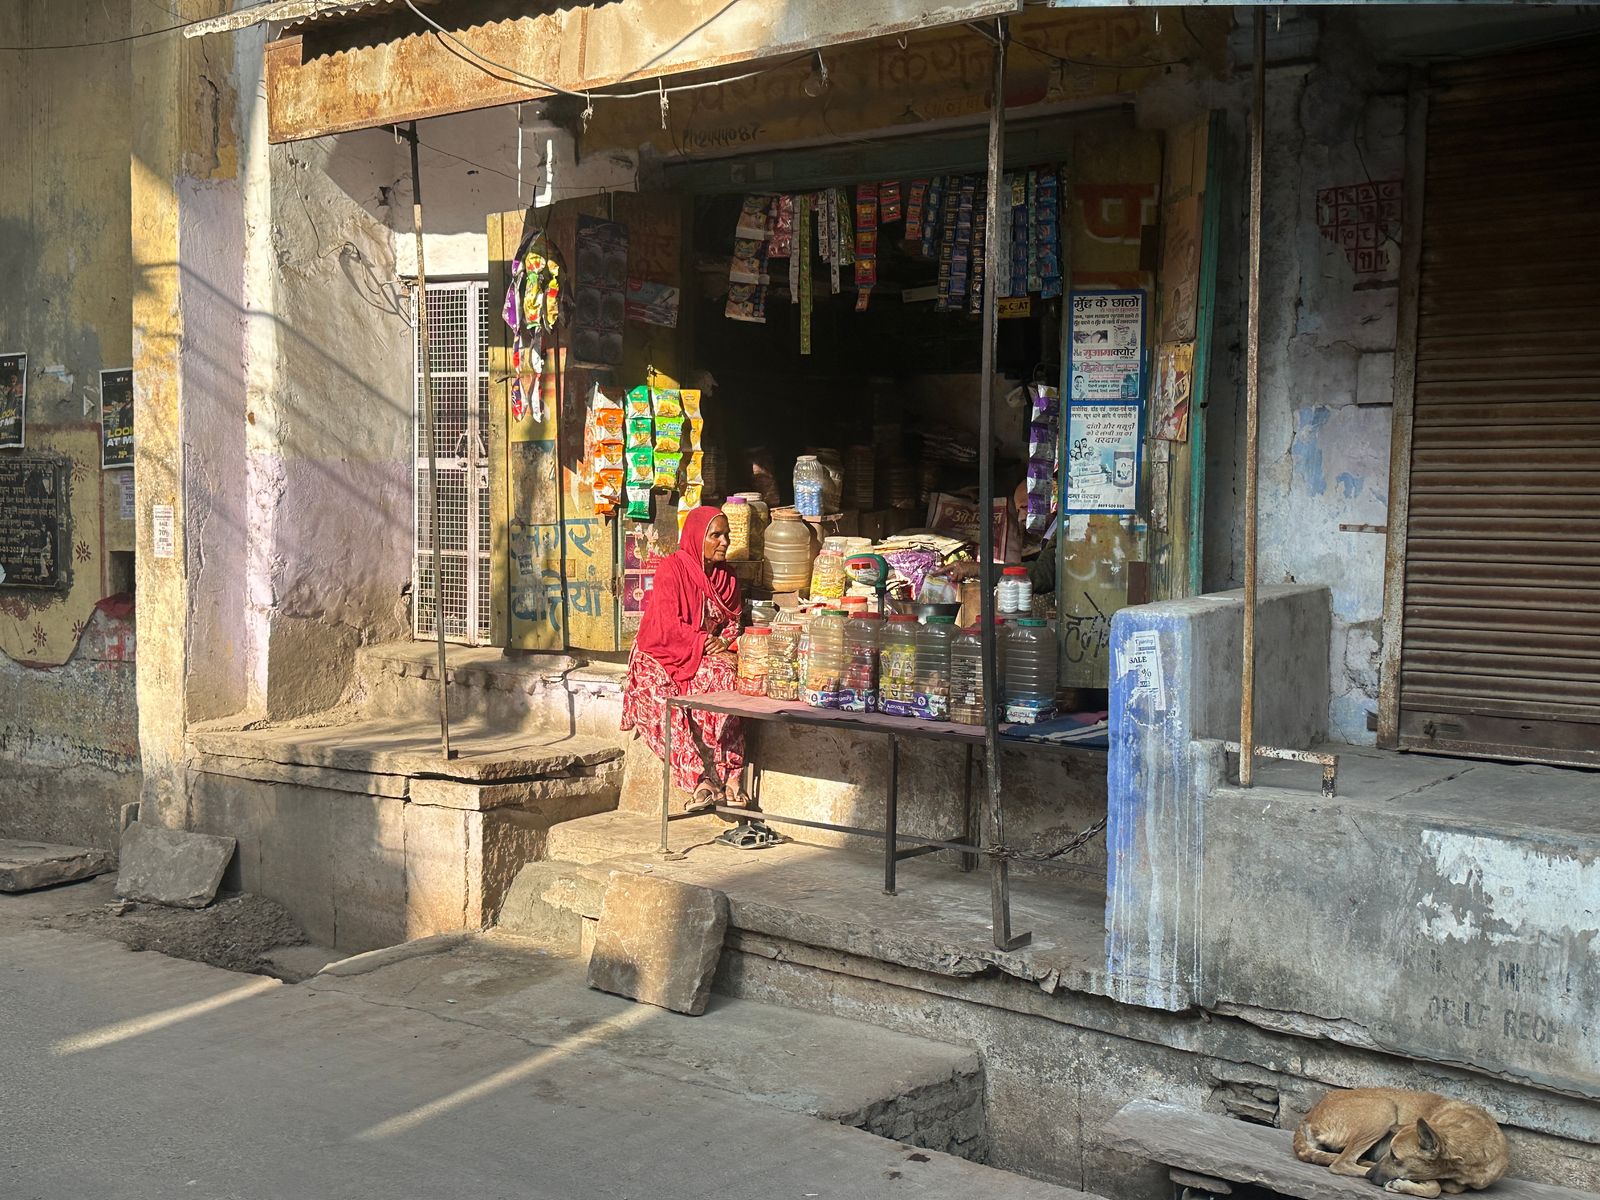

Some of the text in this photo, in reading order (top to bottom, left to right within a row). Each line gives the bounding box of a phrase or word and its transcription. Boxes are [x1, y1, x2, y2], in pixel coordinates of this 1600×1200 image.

[1095, 296, 1108, 308] के
[106, 437, 121, 447] AT
[1128, 656, 1148, 664] SALE
